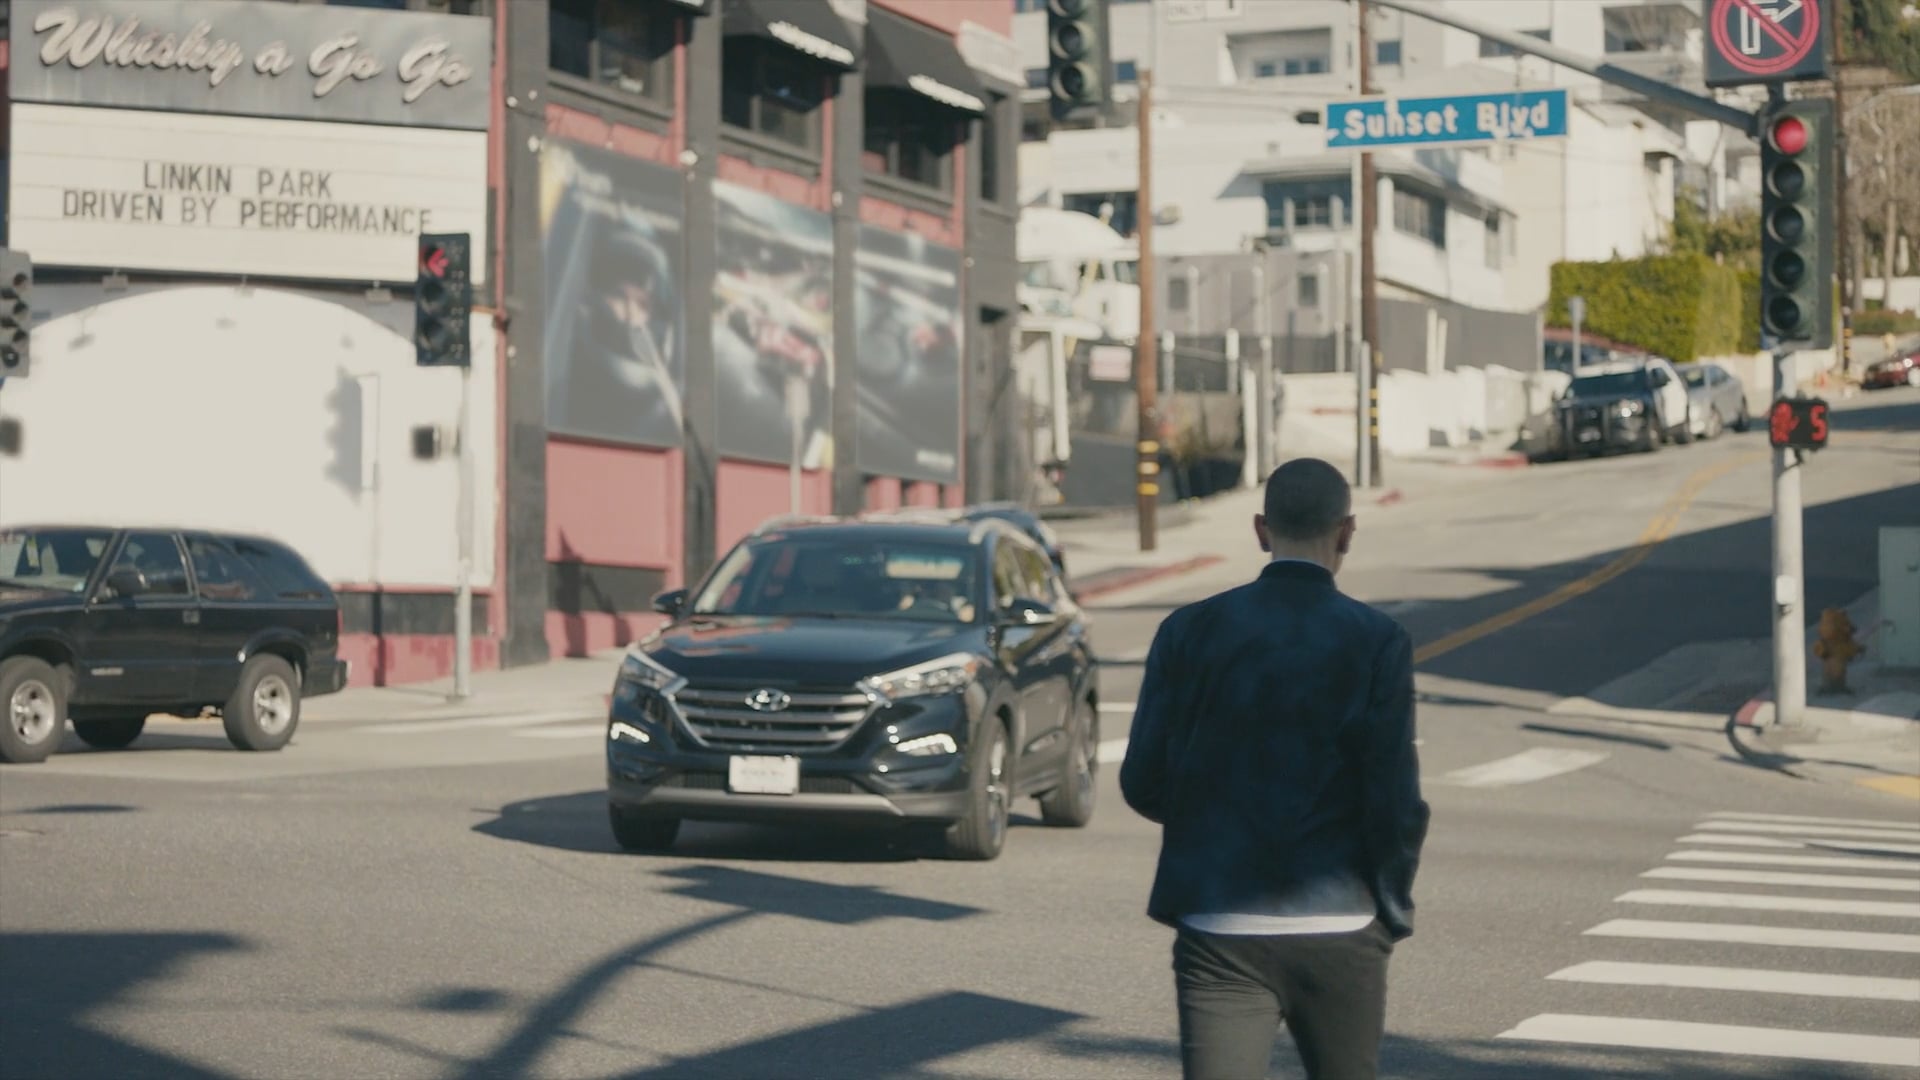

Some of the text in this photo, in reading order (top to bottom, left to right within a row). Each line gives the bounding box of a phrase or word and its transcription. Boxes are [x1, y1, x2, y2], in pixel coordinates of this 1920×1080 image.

[34, 8, 473, 102] Whisky a Go Go
[1343, 100, 1549, 140] Sunset Blvd
[144, 161, 332, 199] LINKIN PARK
[63, 189, 432, 234] DRIVEN BY PERFORMANCE
[1810, 404, 1826, 441] 5
